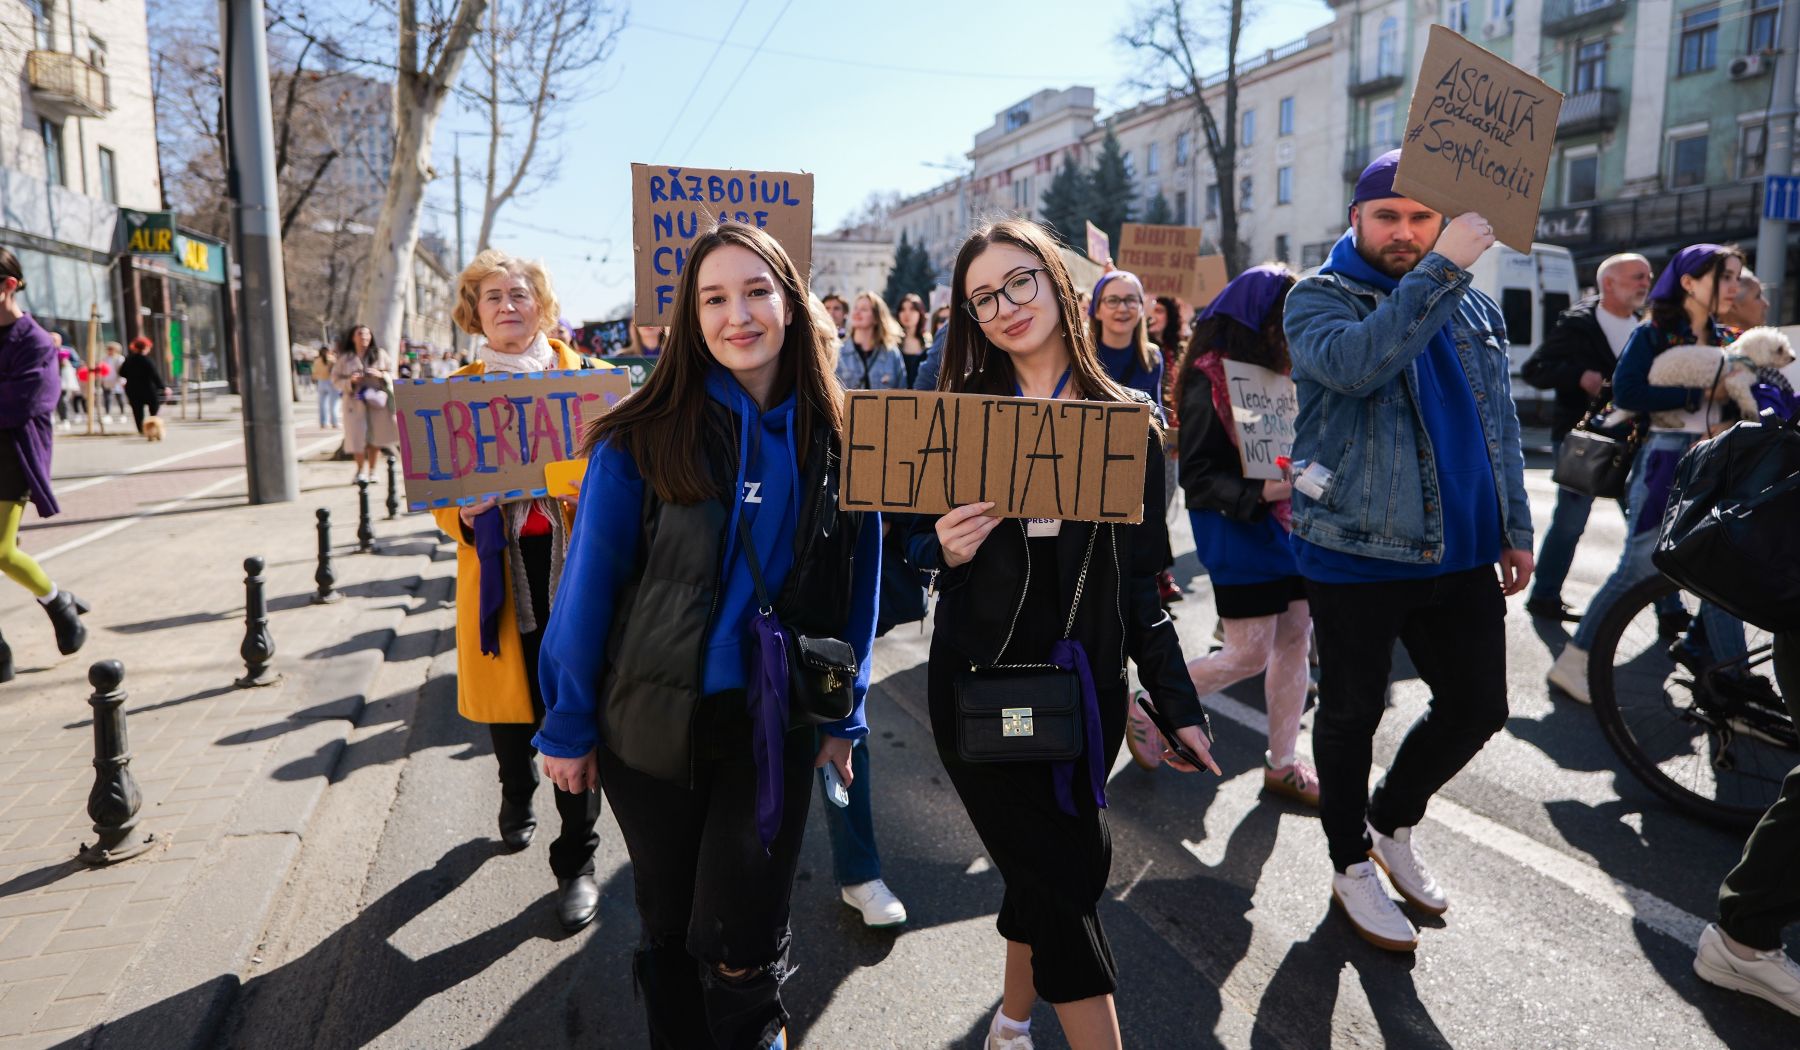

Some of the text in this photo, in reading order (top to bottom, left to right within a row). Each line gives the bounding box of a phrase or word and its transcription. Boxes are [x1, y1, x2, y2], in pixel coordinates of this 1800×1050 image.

[1436, 58, 1544, 141] ASCULTĂ
[1424, 95, 1515, 147] podcastul
[129, 228, 172, 252] AUR
[654, 210, 697, 241] NU
[653, 246, 690, 276] CH
[1231, 377, 1272, 409] Teach
[846, 396, 1140, 517] EGALITATE
[1244, 440, 1273, 465] NOT
